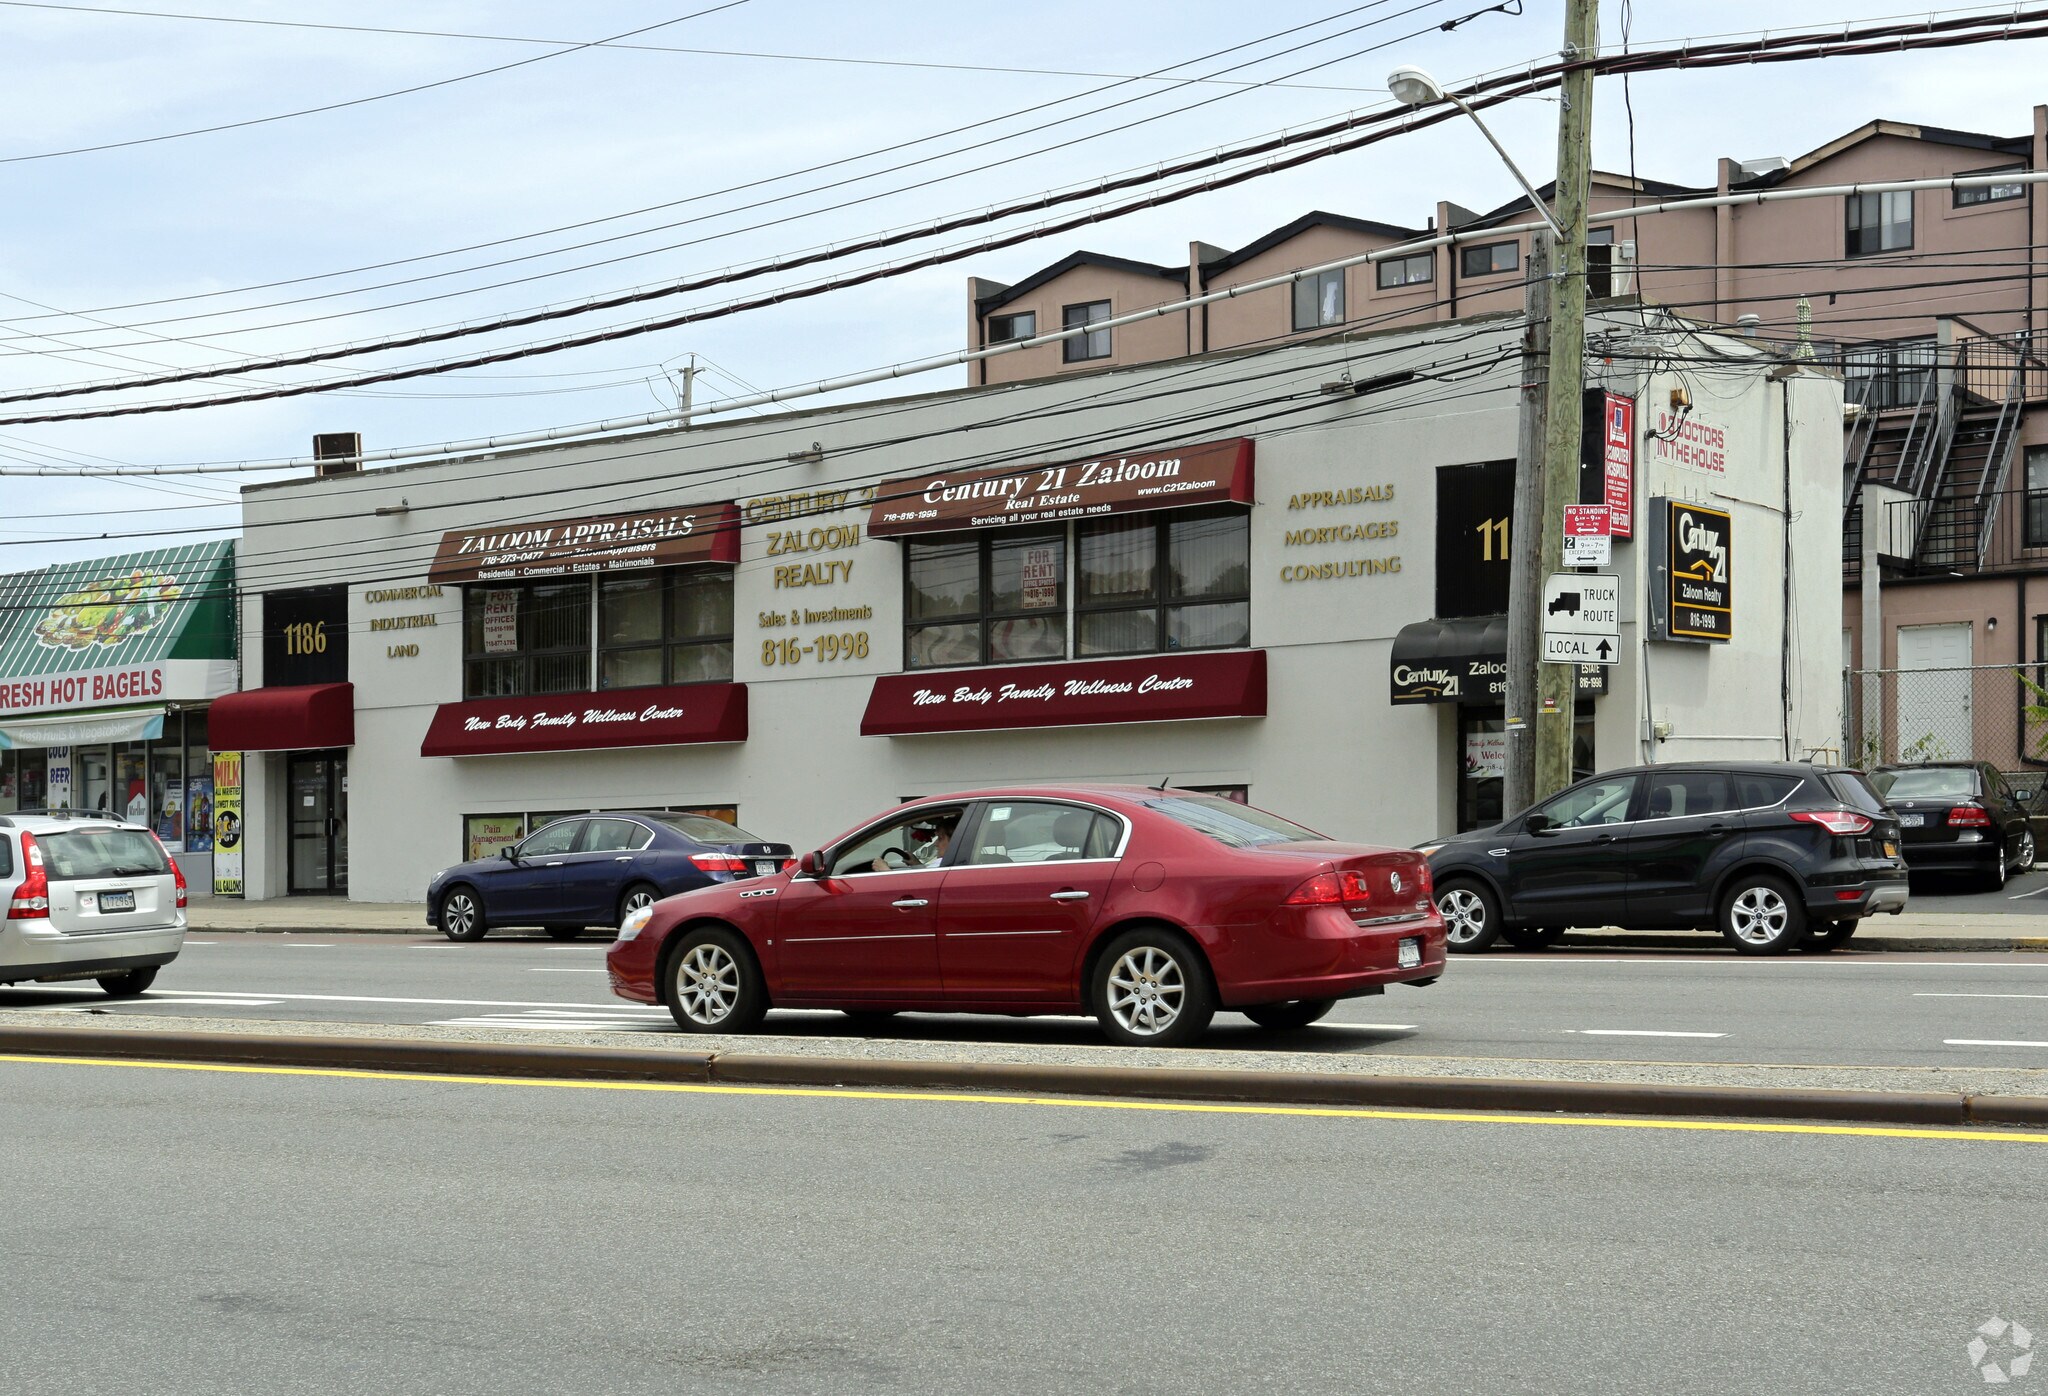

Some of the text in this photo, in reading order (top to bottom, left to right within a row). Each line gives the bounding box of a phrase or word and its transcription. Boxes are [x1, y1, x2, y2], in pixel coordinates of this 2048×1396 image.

[1677, 418, 1724, 449] DOCTORS
[1669, 440, 1690, 464] THE
[1691, 446, 1725, 473] HOUSE
[923, 456, 1182, 505] Century 21 Zaloom
[1137, 479, 1216, 496] www.C21Zaloom
[1004, 492, 1081, 511] Real Estate
[1288, 483, 1394, 509] APPRAISALS
[746, 489, 849, 523] CENTURY
[883, 508, 938, 522] 718-816-1998
[971, 503, 1112, 527] Servicing all your real estate needs
[458, 514, 696, 555] ZALOOM APPRAISALS
[766, 524, 860, 555] ZALOOM
[1284, 520, 1398, 546] MORTGAGES
[1566, 537, 1574, 548] 2
[1028, 550, 1050, 564] FOR
[1679, 512, 1728, 584] Century 21
[478, 557, 655, 579] Residential Commercial Estates Matrimonials
[481, 551, 544, 566] 718-273-0477
[774, 560, 854, 588] REALTY
[1023, 563, 1054, 579] RENT
[1280, 556, 1402, 582] CONSULTING
[365, 585, 443, 604] COMMERCIAL
[490, 591, 513, 602] FOR
[1583, 588, 1615, 600] TRUCK
[1682, 583, 1722, 606] Zaloom Realty
[486, 603, 516, 615] RENT
[759, 604, 872, 627] Sales & Investments
[1583, 610, 1615, 622] ROUTE
[370, 613, 438, 632] INDUSTRIAL
[485, 615, 515, 625] OFFICES
[1690, 612, 1716, 629] 816-1998
[283, 621, 327, 655] 1186
[1549, 640, 1590, 655] LOCAL
[387, 643, 419, 659] LAND
[761, 631, 869, 666] 816-1998
[1581, 664, 1600, 674] ESTATE
[0, 669, 162, 709] RESH HOT BAGELS
[1393, 664, 1459, 696] Century 21
[1579, 677, 1602, 688] 816-1998
[913, 674, 1194, 706] New Body Family Wellness Center
[464, 704, 684, 731] New Body Family Wellness Center
[48, 746, 68, 759] COLD
[50, 768, 70, 784] BEER
[215, 761, 241, 787] MILK
[215, 799, 241, 809] LOWEST PRICE
[484, 824, 501, 834] Pain
[472, 834, 514, 844] Management
[222, 880, 241, 892] GALLONS
